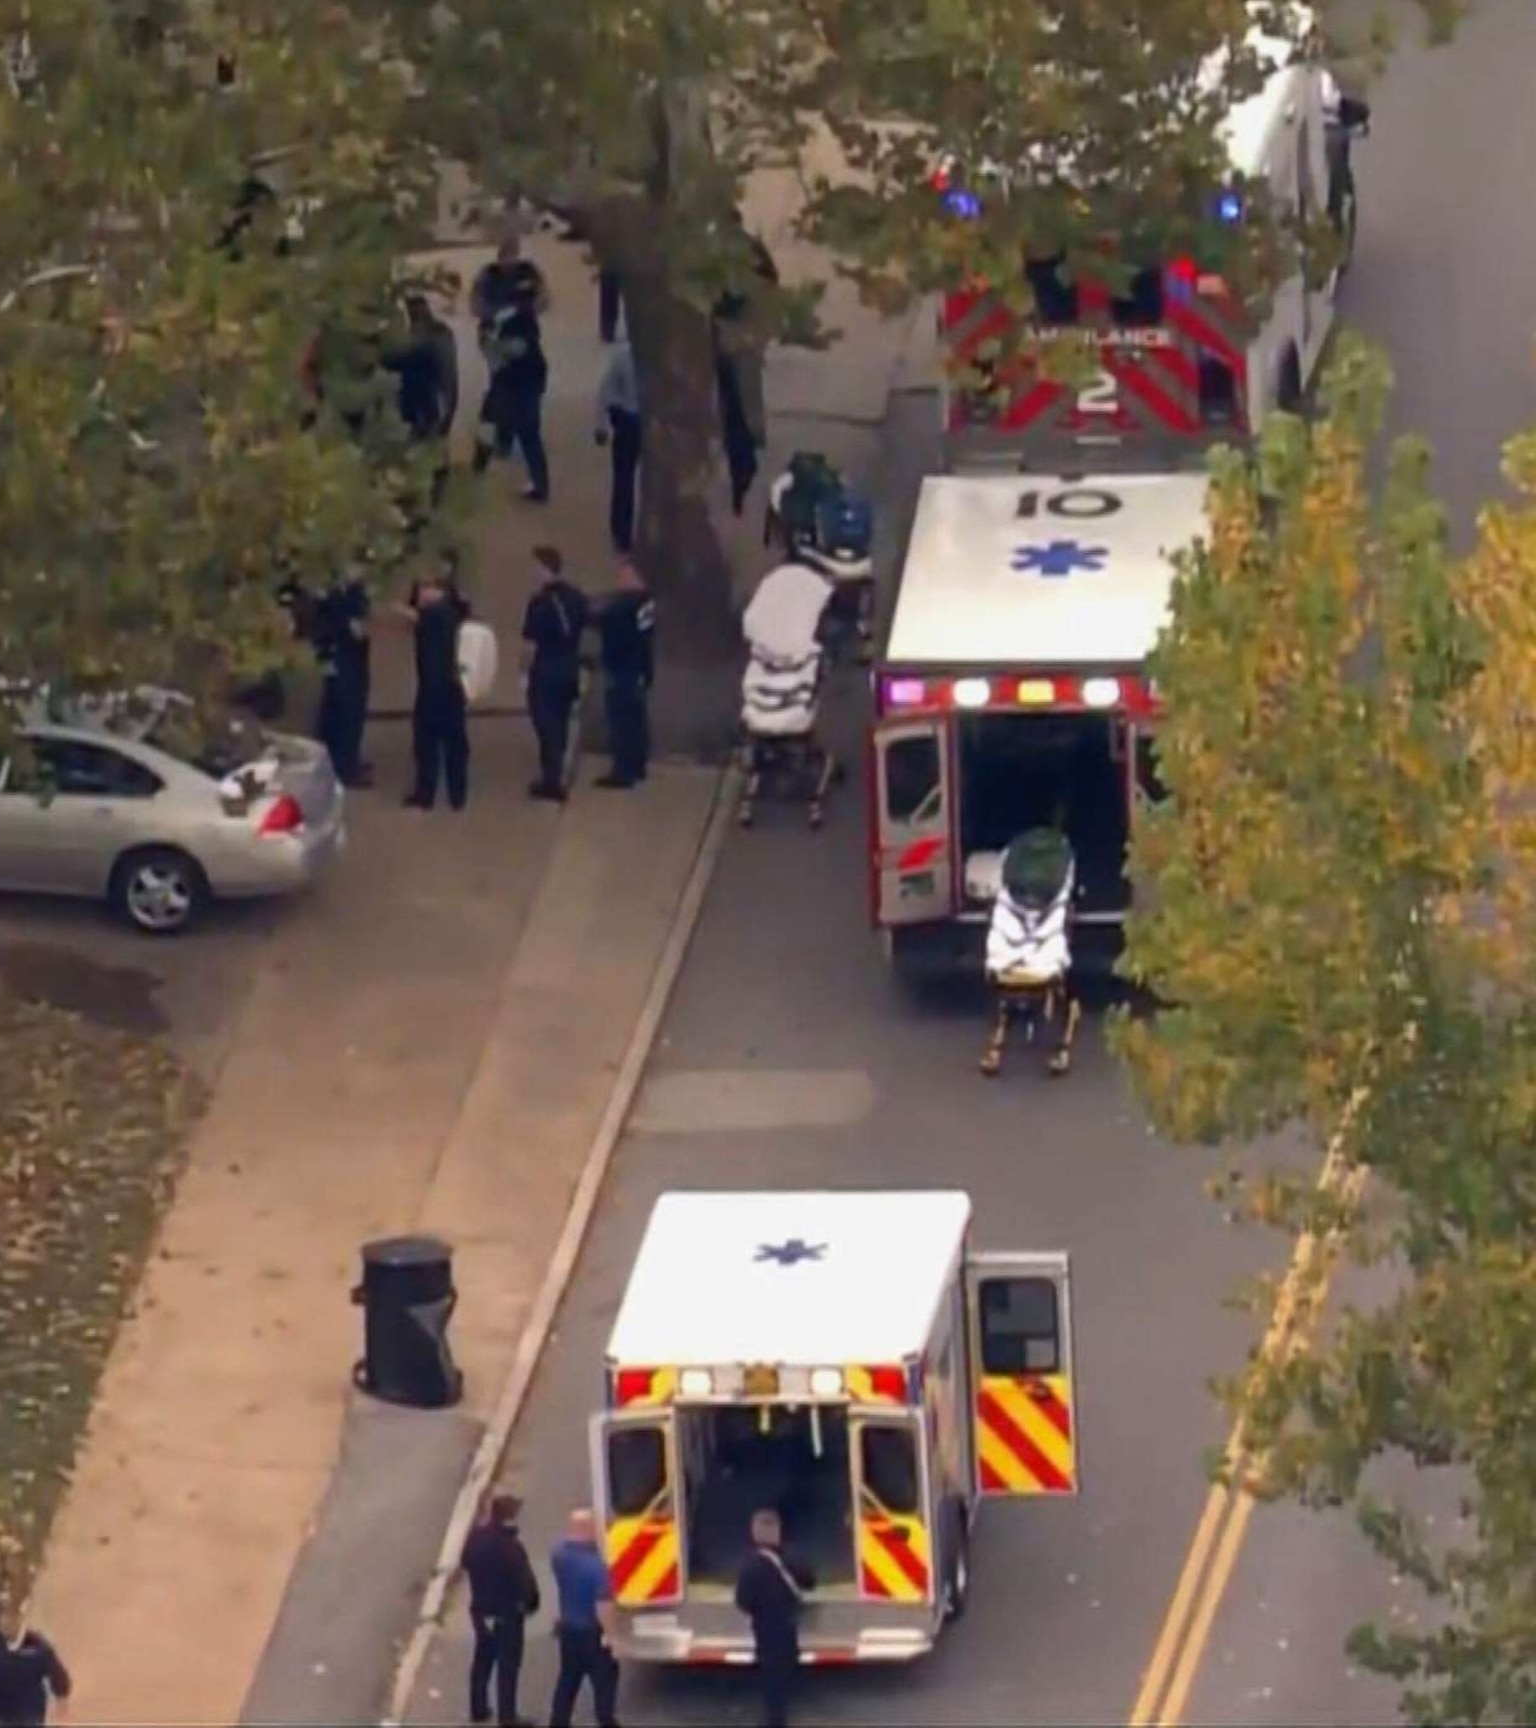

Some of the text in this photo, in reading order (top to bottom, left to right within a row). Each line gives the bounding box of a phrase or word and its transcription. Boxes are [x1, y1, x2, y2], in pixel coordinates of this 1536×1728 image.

[1024, 326, 1171, 347] AMLANCE
[1077, 370, 1119, 412] 2
[1016, 489, 1123, 518] 10
